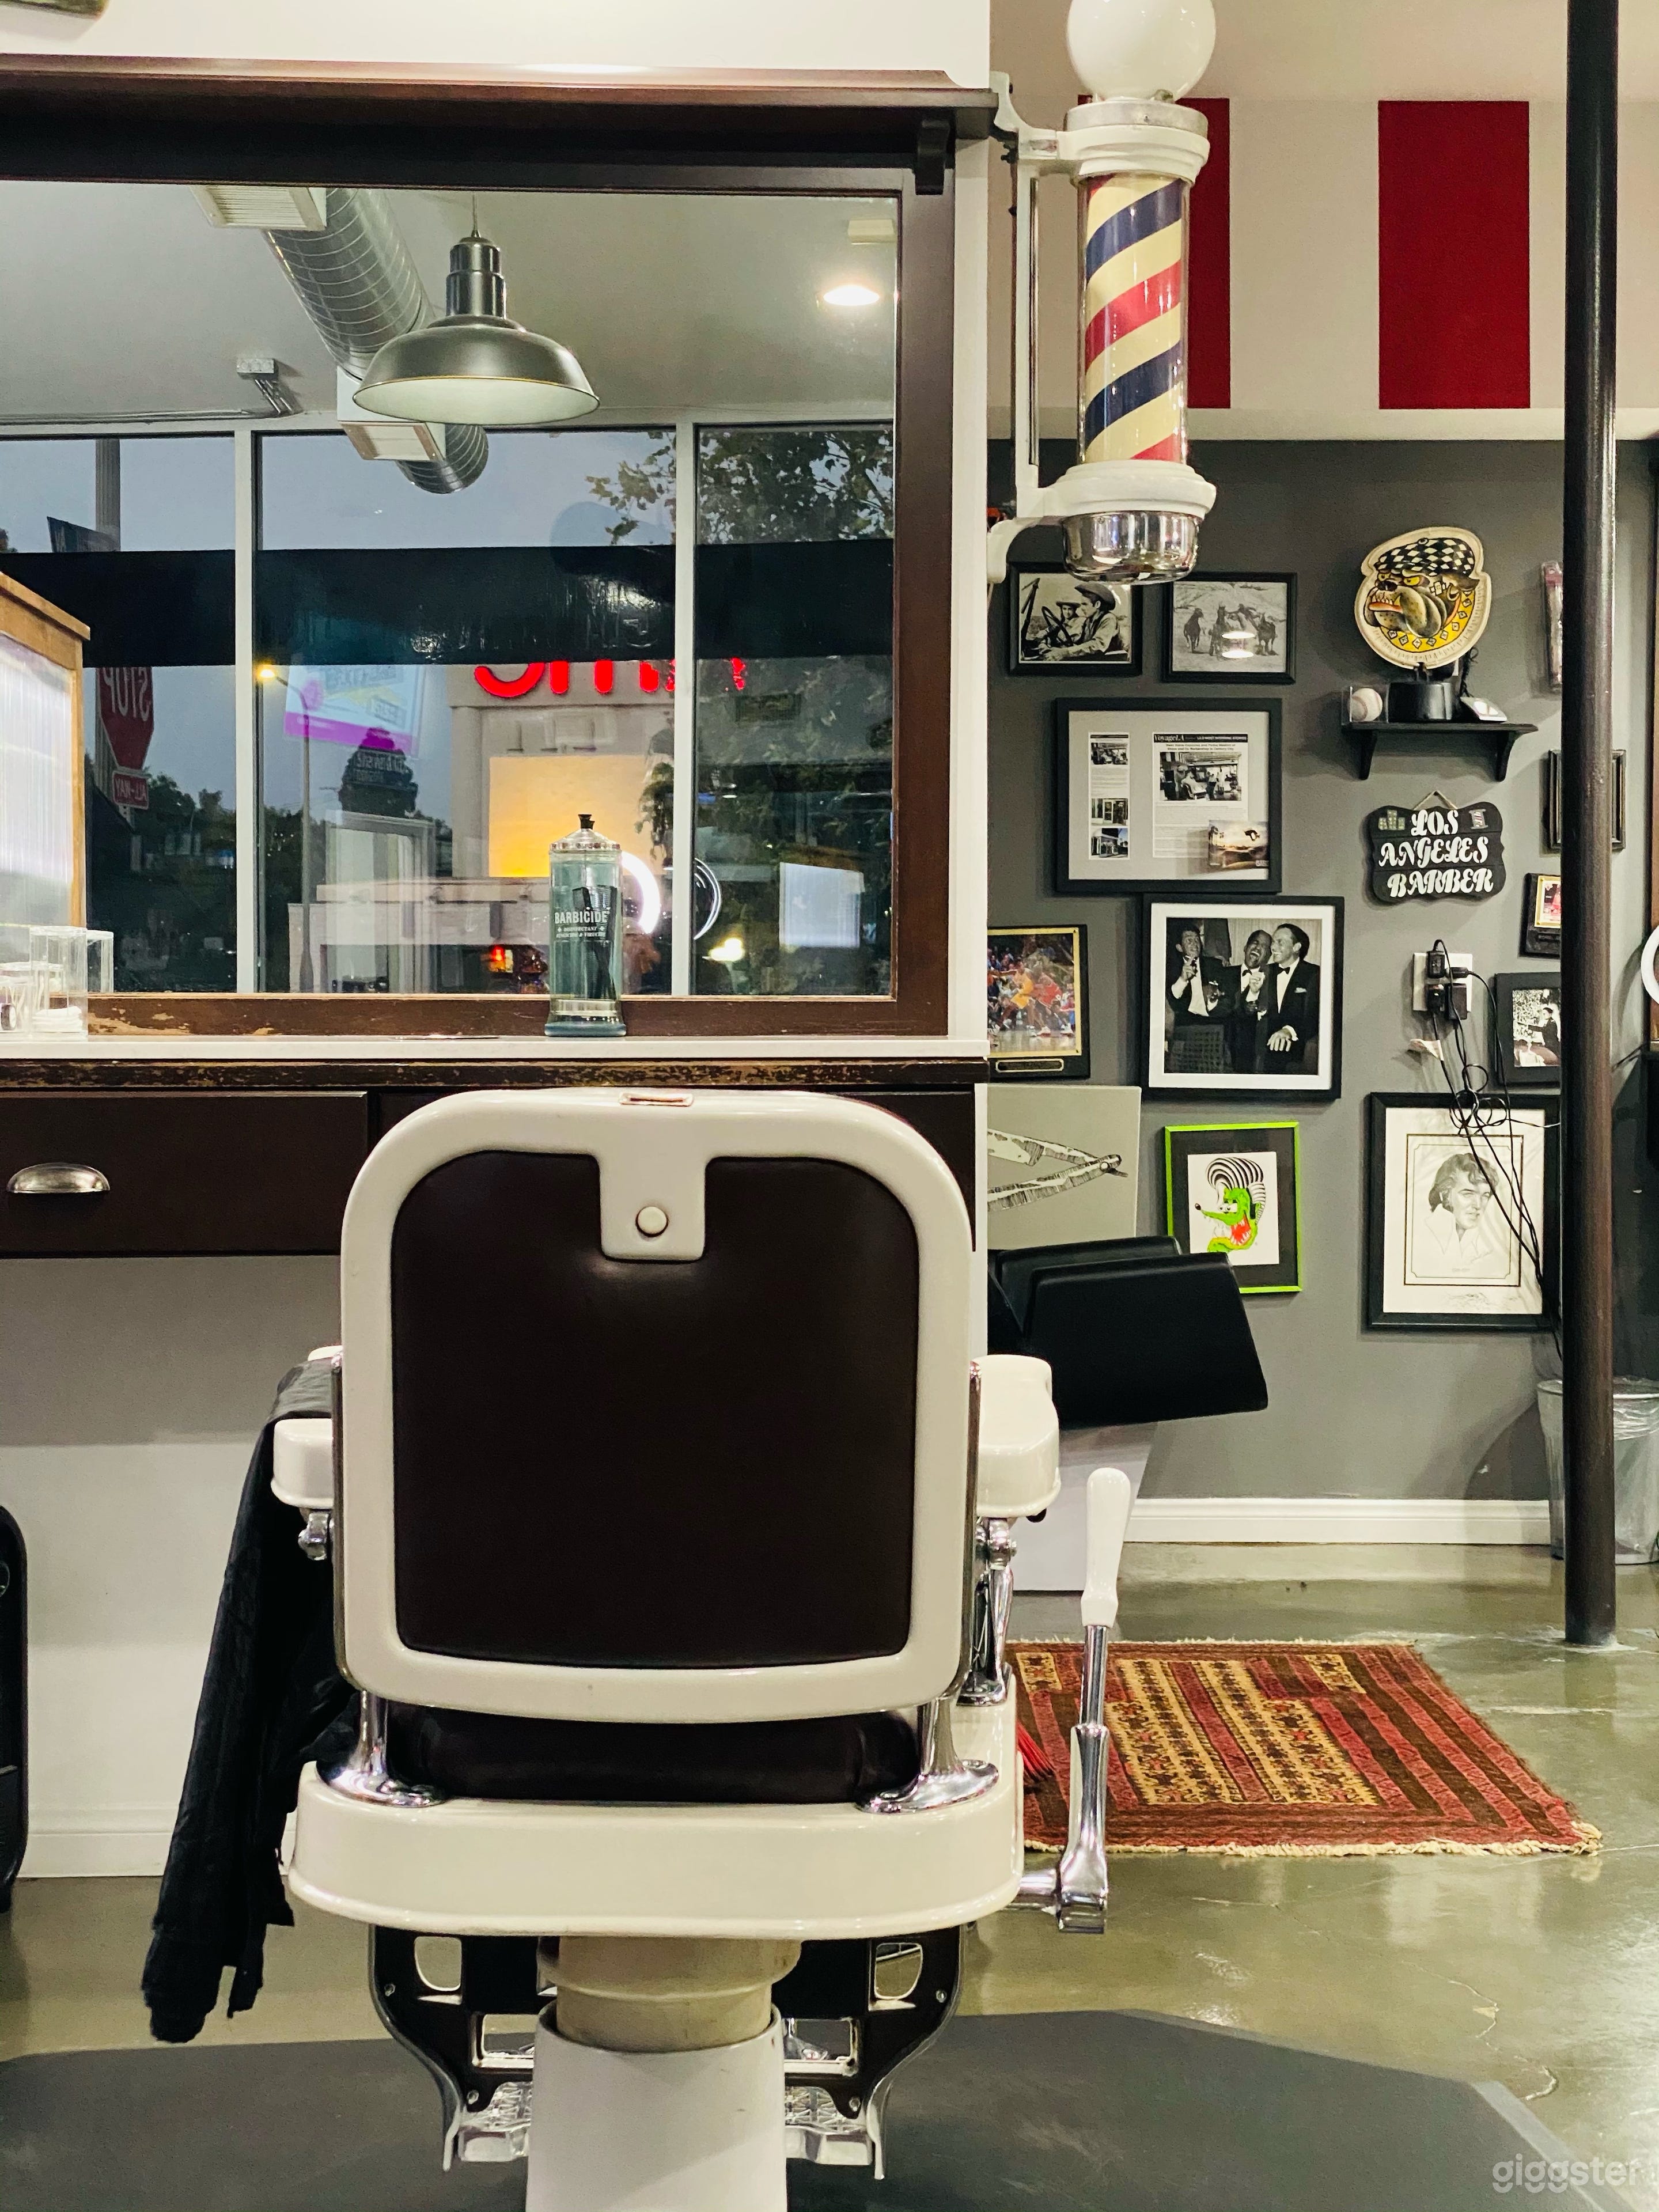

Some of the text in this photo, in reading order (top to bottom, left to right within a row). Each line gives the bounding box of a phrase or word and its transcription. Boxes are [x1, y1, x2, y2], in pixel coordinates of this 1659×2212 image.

[1411, 809, 1459, 836] LOS
[1378, 836, 1489, 868] ANGELES
[1387, 868, 1494, 897] BARBER
[555, 910, 609, 924] BARBICIDE
